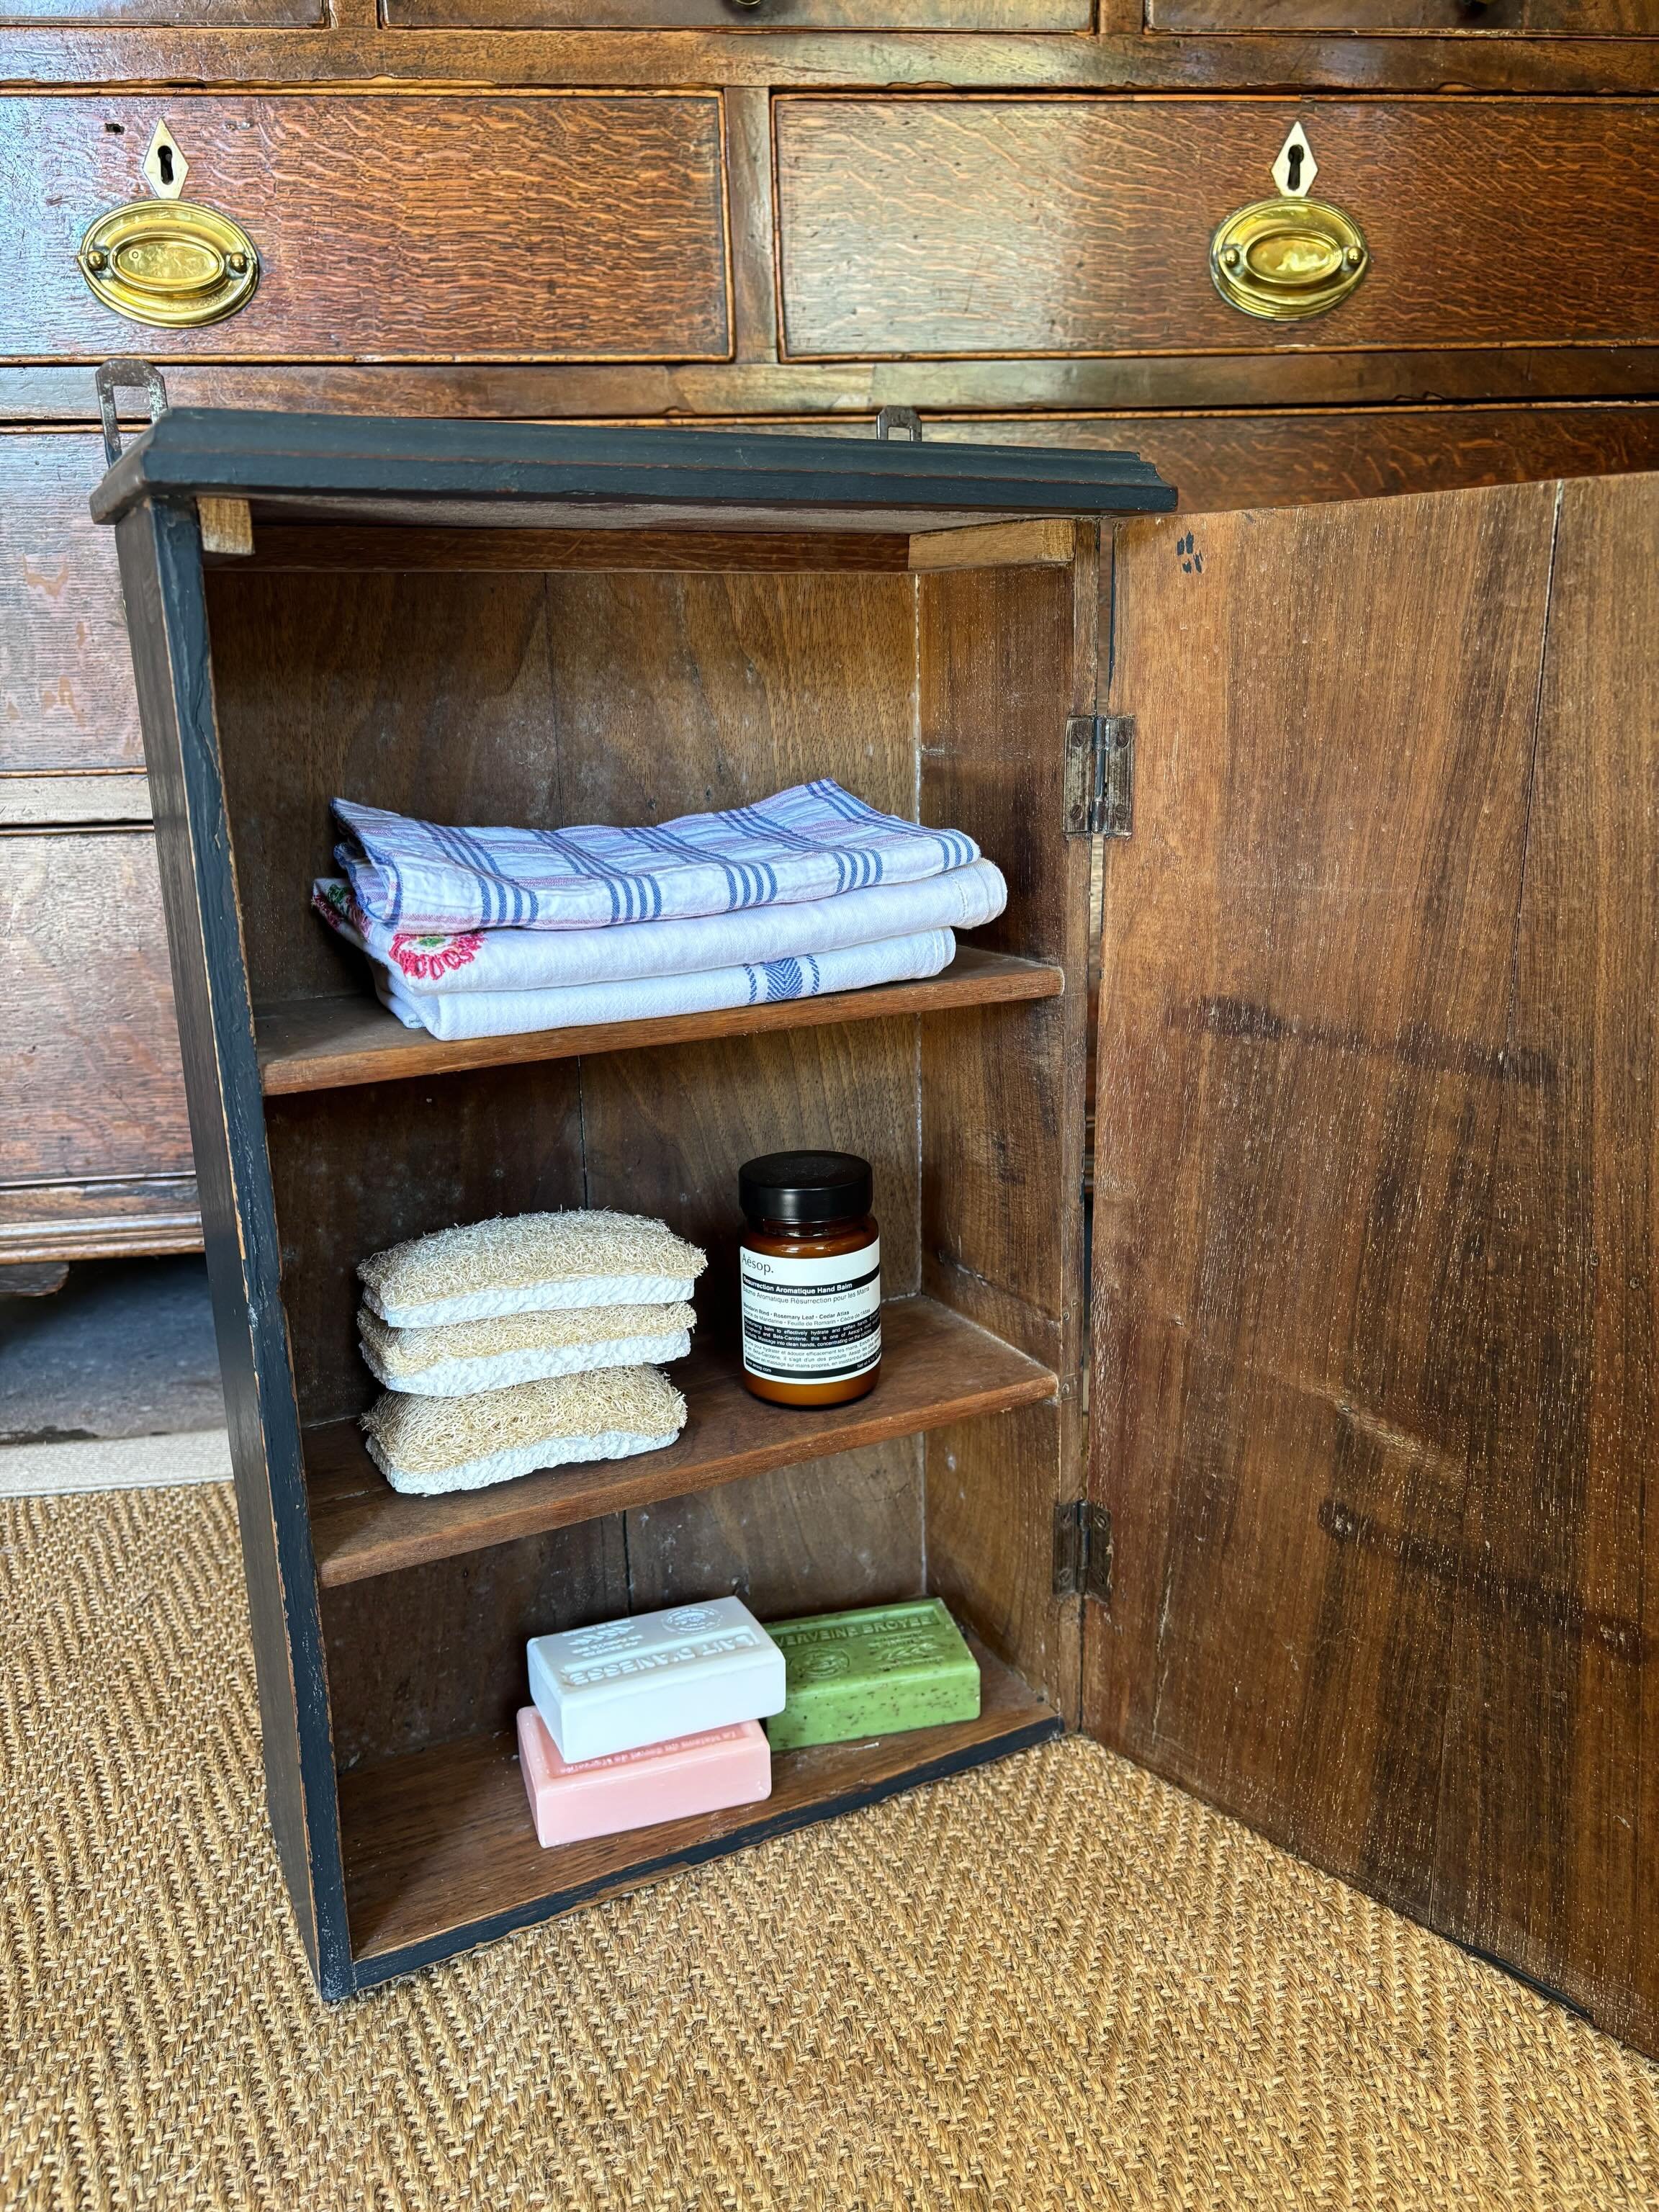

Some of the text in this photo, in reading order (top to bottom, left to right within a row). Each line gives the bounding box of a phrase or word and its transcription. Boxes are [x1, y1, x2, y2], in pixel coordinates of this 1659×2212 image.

[743, 1276, 774, 1292] Resurrection
[776, 1286, 815, 1295] Aromatique
[757, 1292, 788, 1303] Aromatique
[857, 1287, 870, 1296] Mains
[759, 1316, 783, 1324] Mandarine
[817, 1338, 848, 1346] concentrating
[703, 1633, 755, 1656] LAIT
[775, 1626, 858, 1647] VERVEINE
